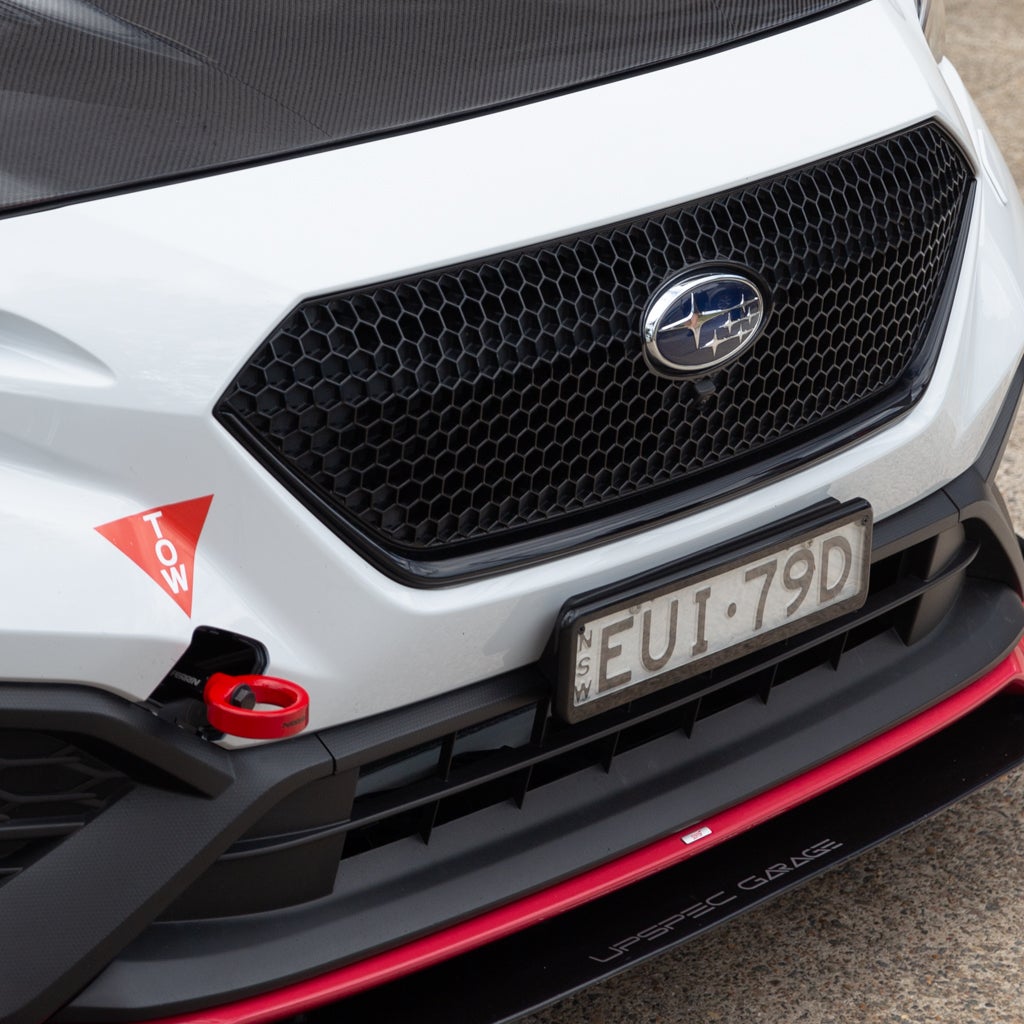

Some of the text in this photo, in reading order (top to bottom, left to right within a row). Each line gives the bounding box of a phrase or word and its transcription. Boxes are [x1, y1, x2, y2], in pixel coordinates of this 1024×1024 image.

[142, 510, 189, 595] TOW
[589, 838, 843, 963] UPSPEC GARAGE
